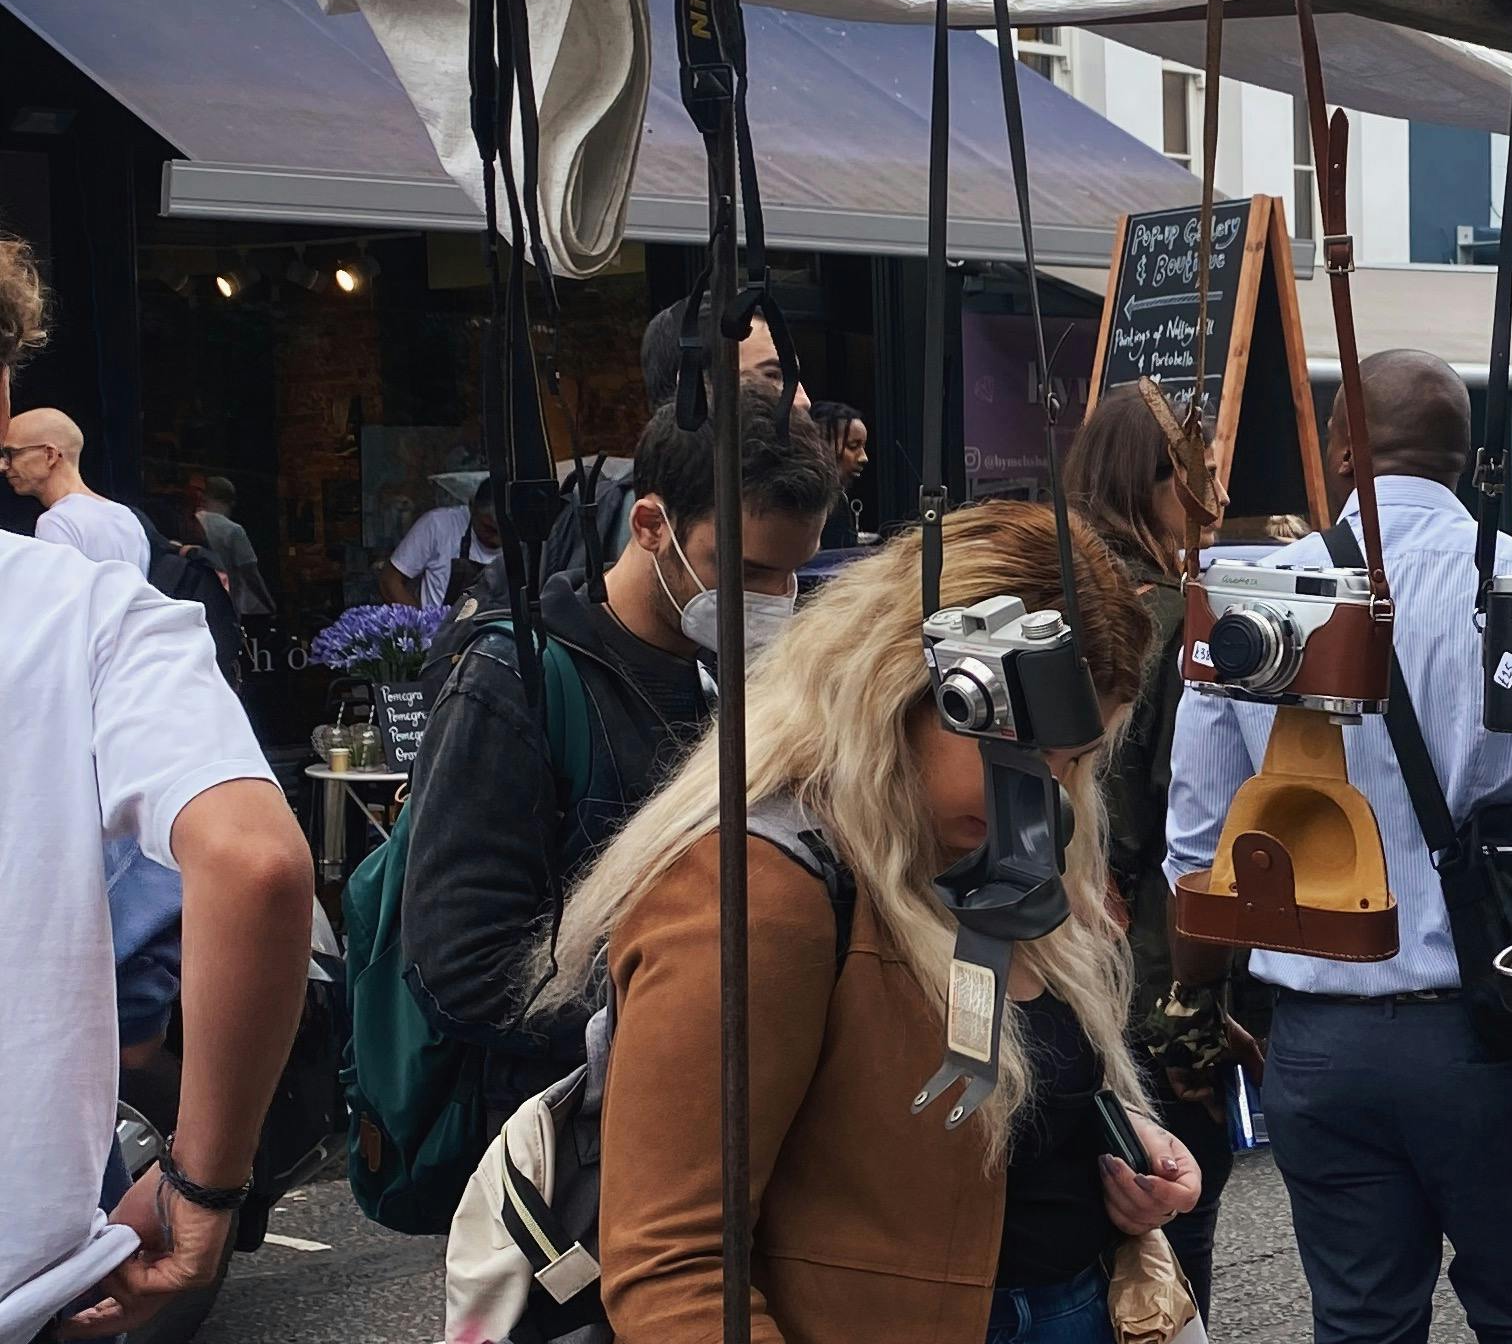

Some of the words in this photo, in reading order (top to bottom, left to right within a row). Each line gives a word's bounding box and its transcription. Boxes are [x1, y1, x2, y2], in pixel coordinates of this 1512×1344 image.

[1131, 224, 1180, 255] Pop-up
[1184, 215, 1241, 250] Glery
[1152, 250, 1225, 289] Boutiue
[1151, 351, 1194, 372] Portobello
